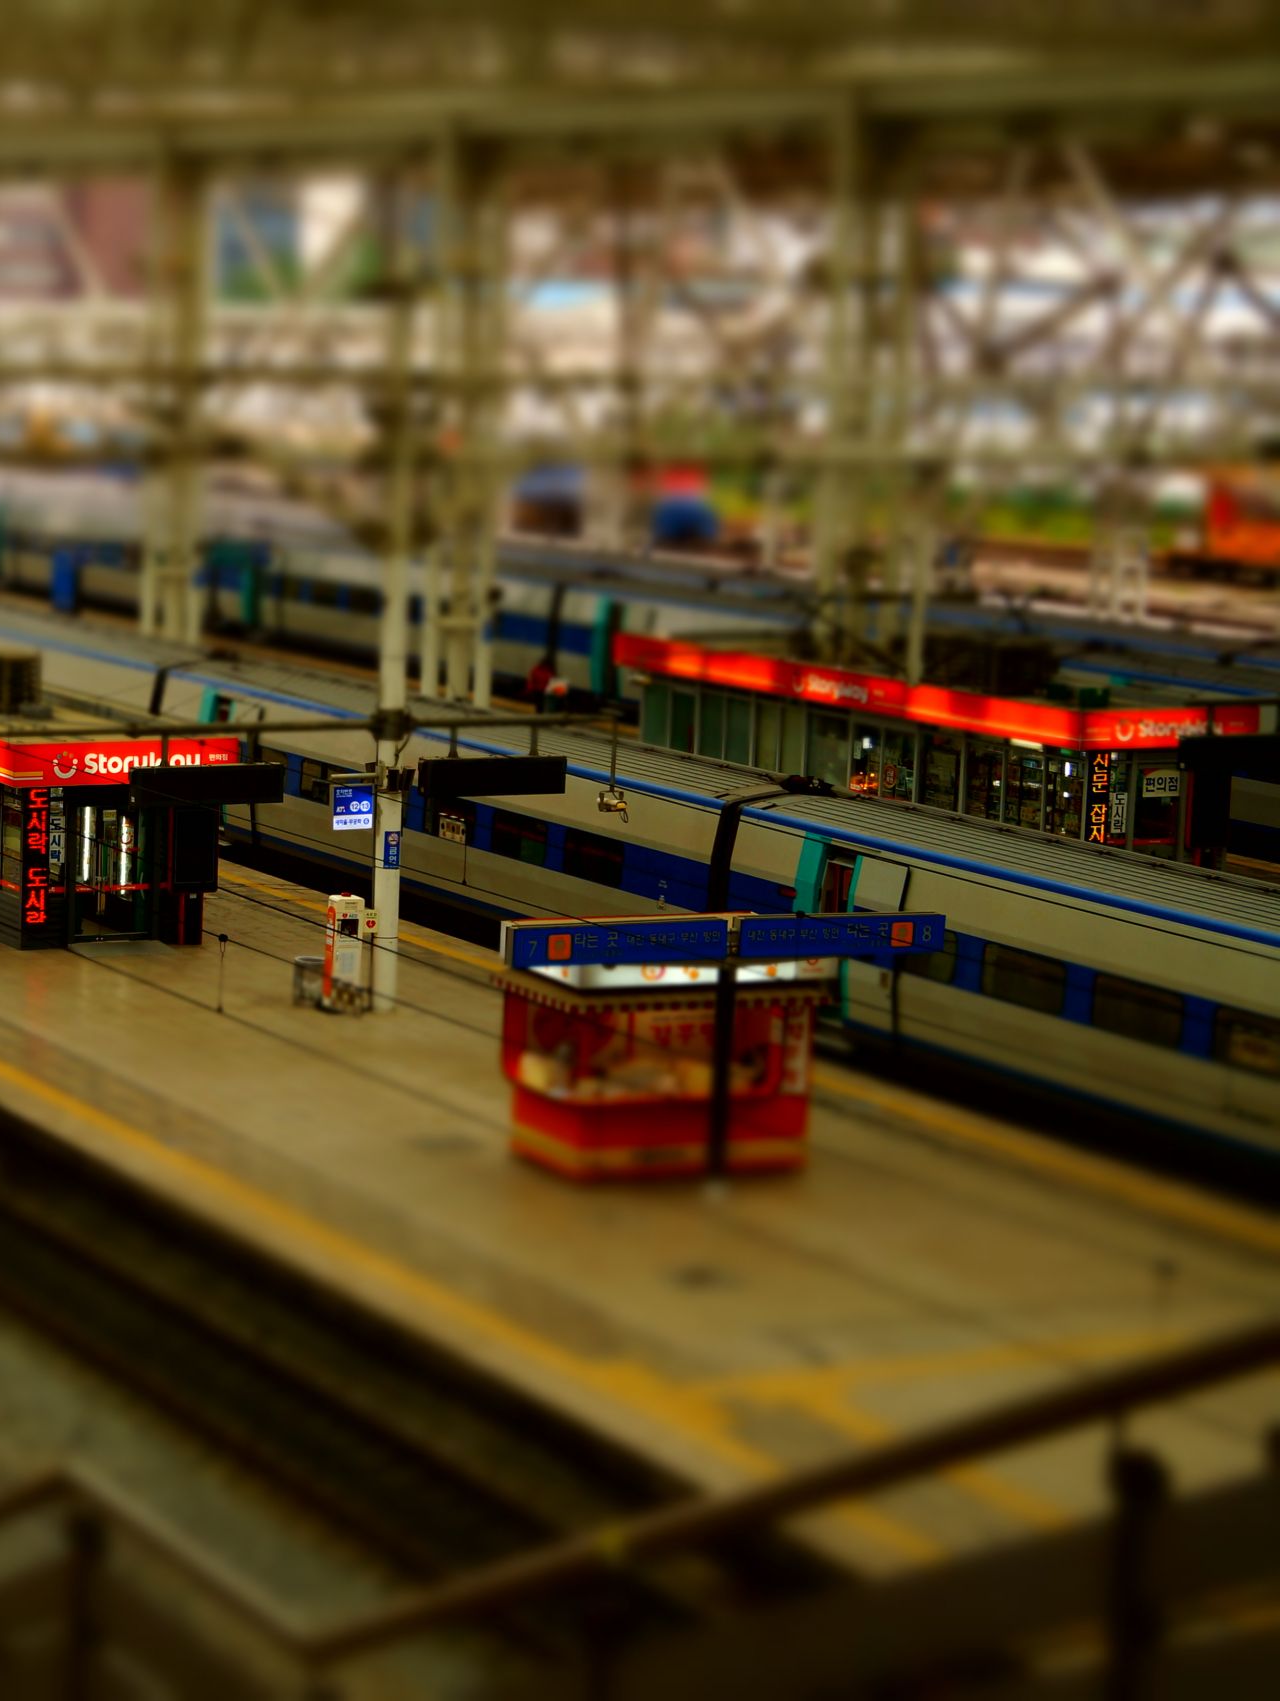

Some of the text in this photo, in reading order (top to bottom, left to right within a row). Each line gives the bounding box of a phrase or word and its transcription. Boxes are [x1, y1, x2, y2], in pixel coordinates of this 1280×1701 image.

[1088, 753, 1110, 844] 신문 잡지
[1145, 776, 1179, 793] 편의점
[26, 788, 49, 855] 도시락
[1113, 793, 1127, 833] 도시락
[50, 817, 64, 863] 도시락
[527, 940, 538, 958] 7
[574, 932, 599, 950] 타는
[607, 931, 619, 949] 곳
[679, 931, 699, 944] 부산
[799, 926, 818, 941] 부산
[846, 922, 871, 939] 타는
[921, 925, 932, 942] 8
